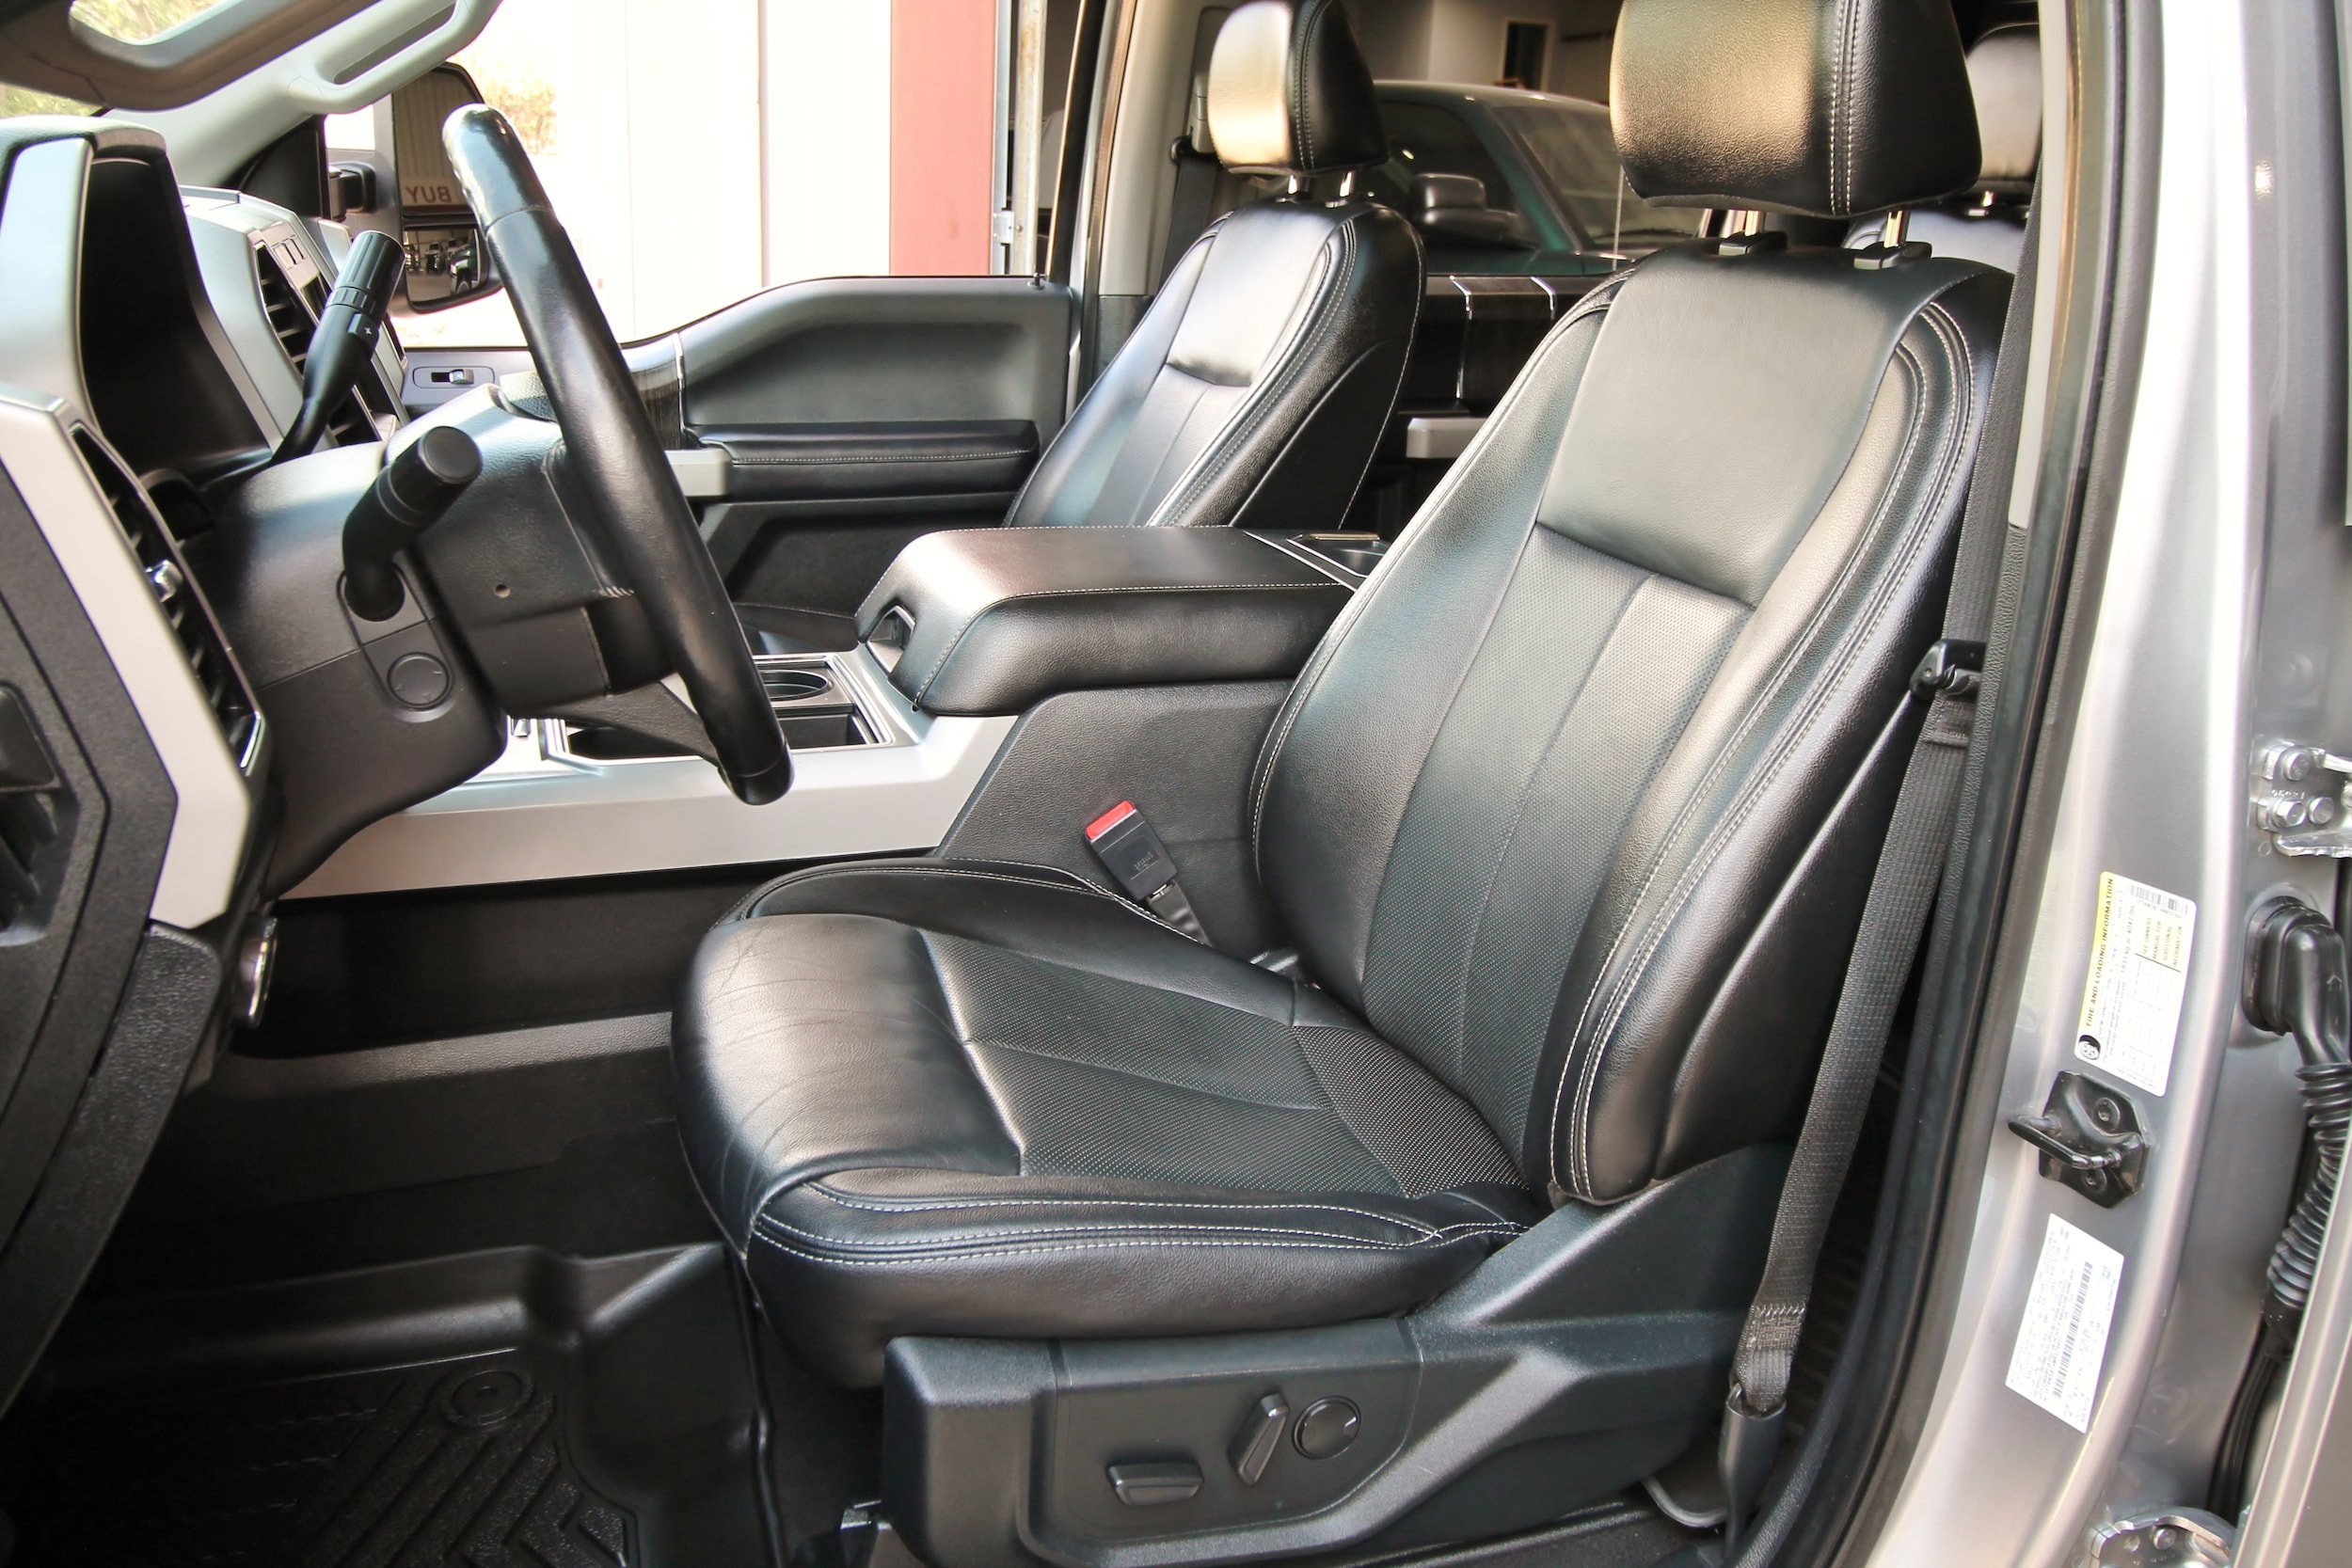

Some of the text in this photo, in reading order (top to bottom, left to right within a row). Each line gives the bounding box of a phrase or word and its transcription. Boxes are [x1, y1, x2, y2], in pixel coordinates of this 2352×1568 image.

[2100, 878, 2115, 942] INFORMATION
[2094, 943, 2106, 985] LOADING
[2090, 986, 2099, 1006] AND
[2086, 1006, 2095, 1028] TIRE
